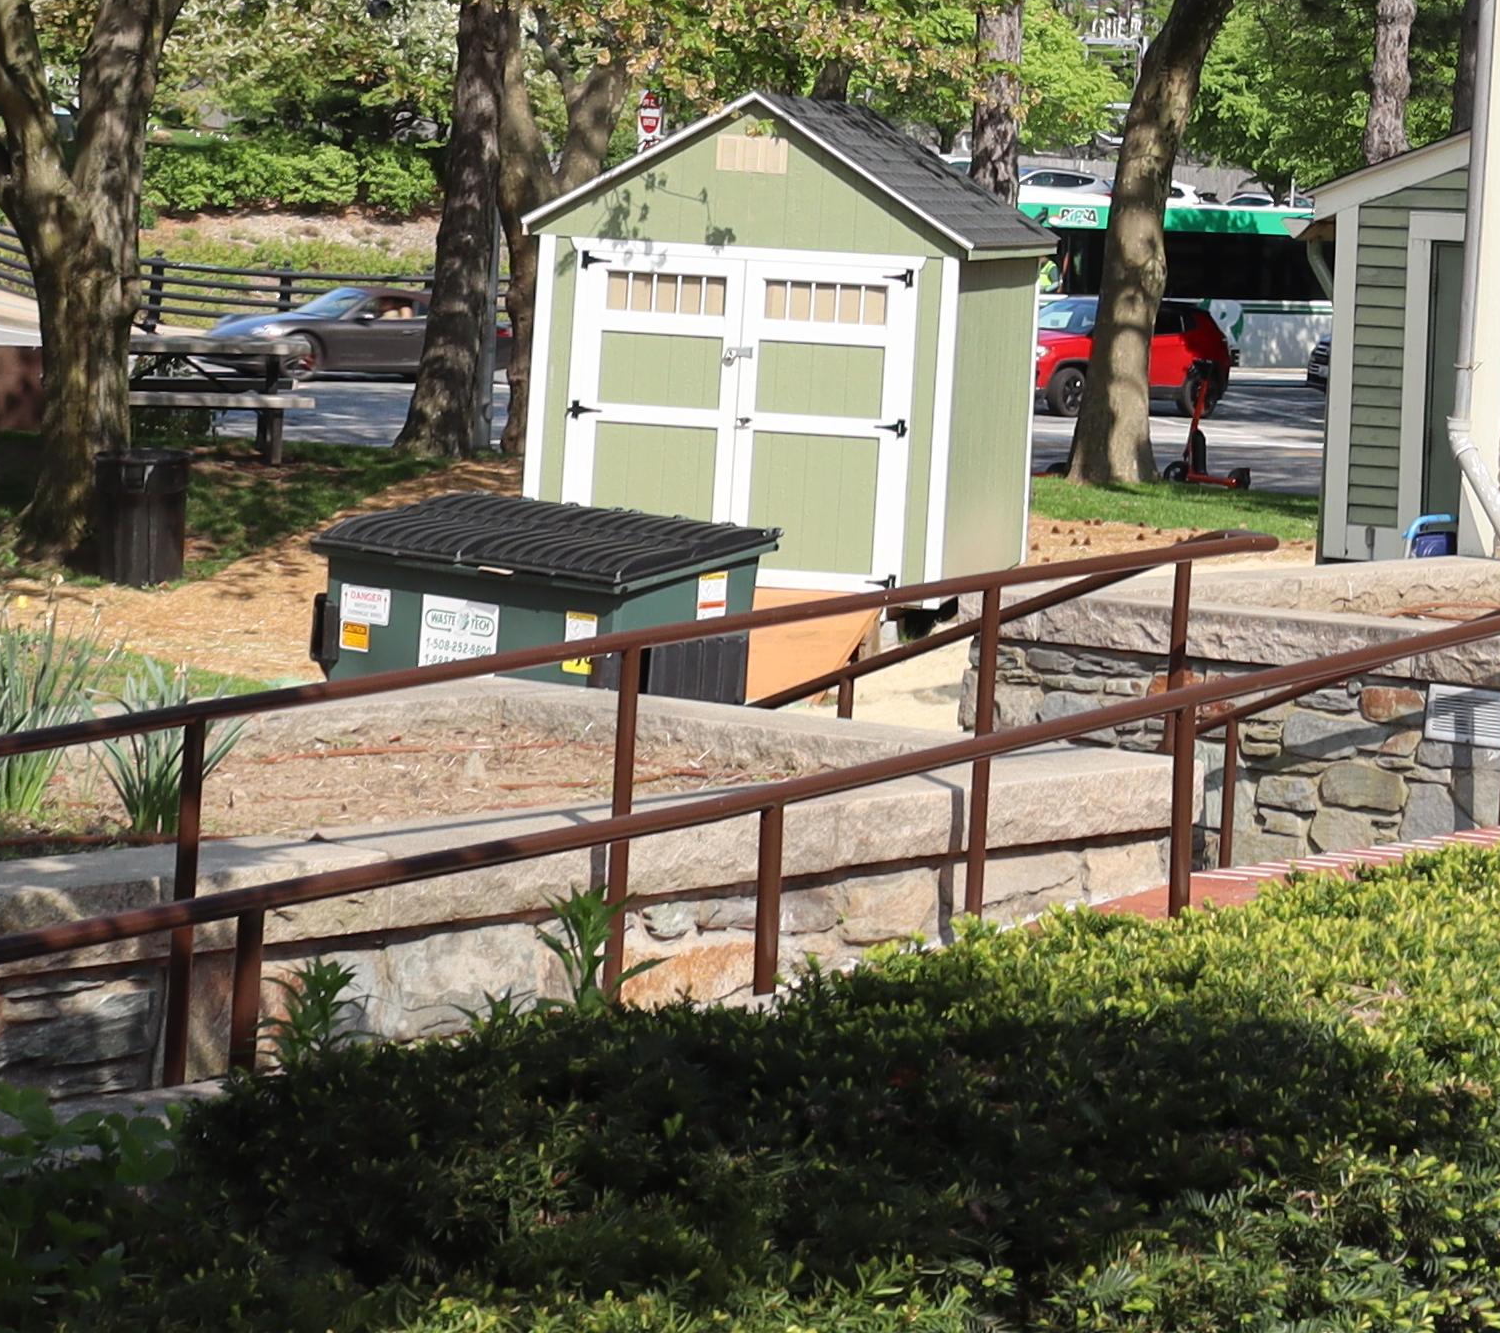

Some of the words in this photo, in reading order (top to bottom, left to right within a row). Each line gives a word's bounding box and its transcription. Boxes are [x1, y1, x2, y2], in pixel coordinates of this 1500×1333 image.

[350, 590, 382, 603] DANGER
[430, 612, 456, 626] WASTE
[471, 618, 491, 631] TECH
